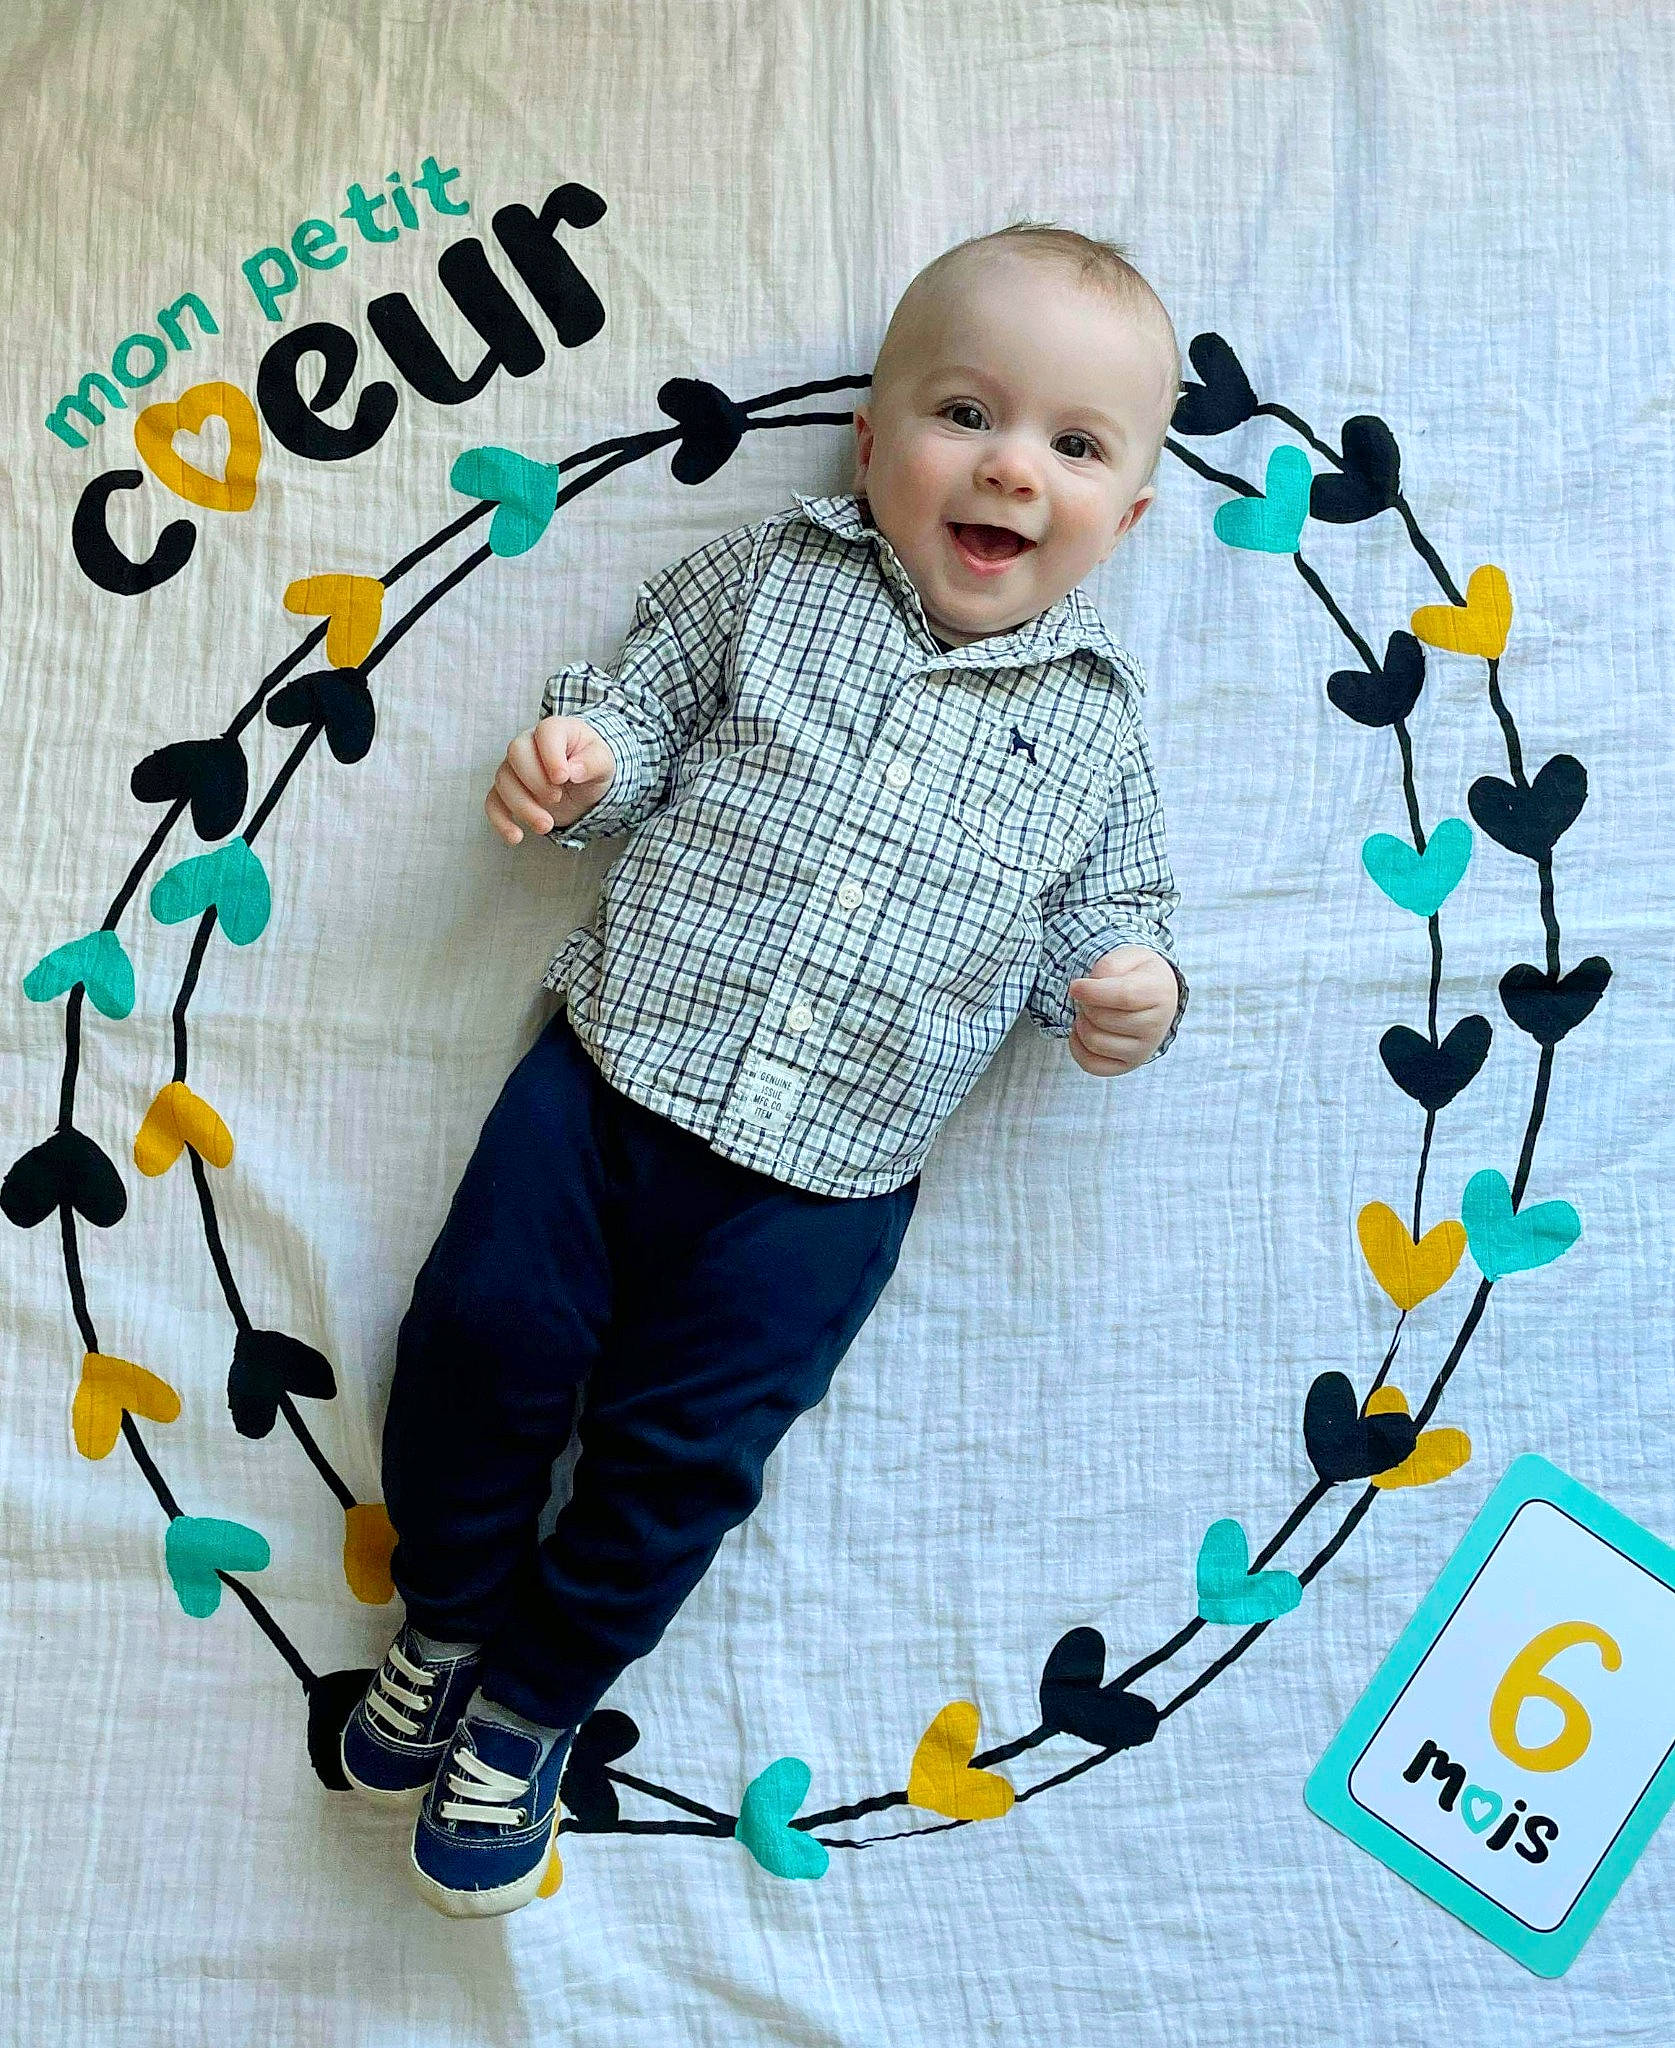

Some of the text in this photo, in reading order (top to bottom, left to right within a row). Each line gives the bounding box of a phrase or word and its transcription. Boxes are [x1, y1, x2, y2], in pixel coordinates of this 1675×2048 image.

[45, 156, 470, 449] mon petit
[760, 1072, 792, 1090] GENUINE
[761, 1085, 782, 1100] ISSUE
[754, 1107, 773, 1119] ITEM
[1489, 1621, 1622, 1772] 6
